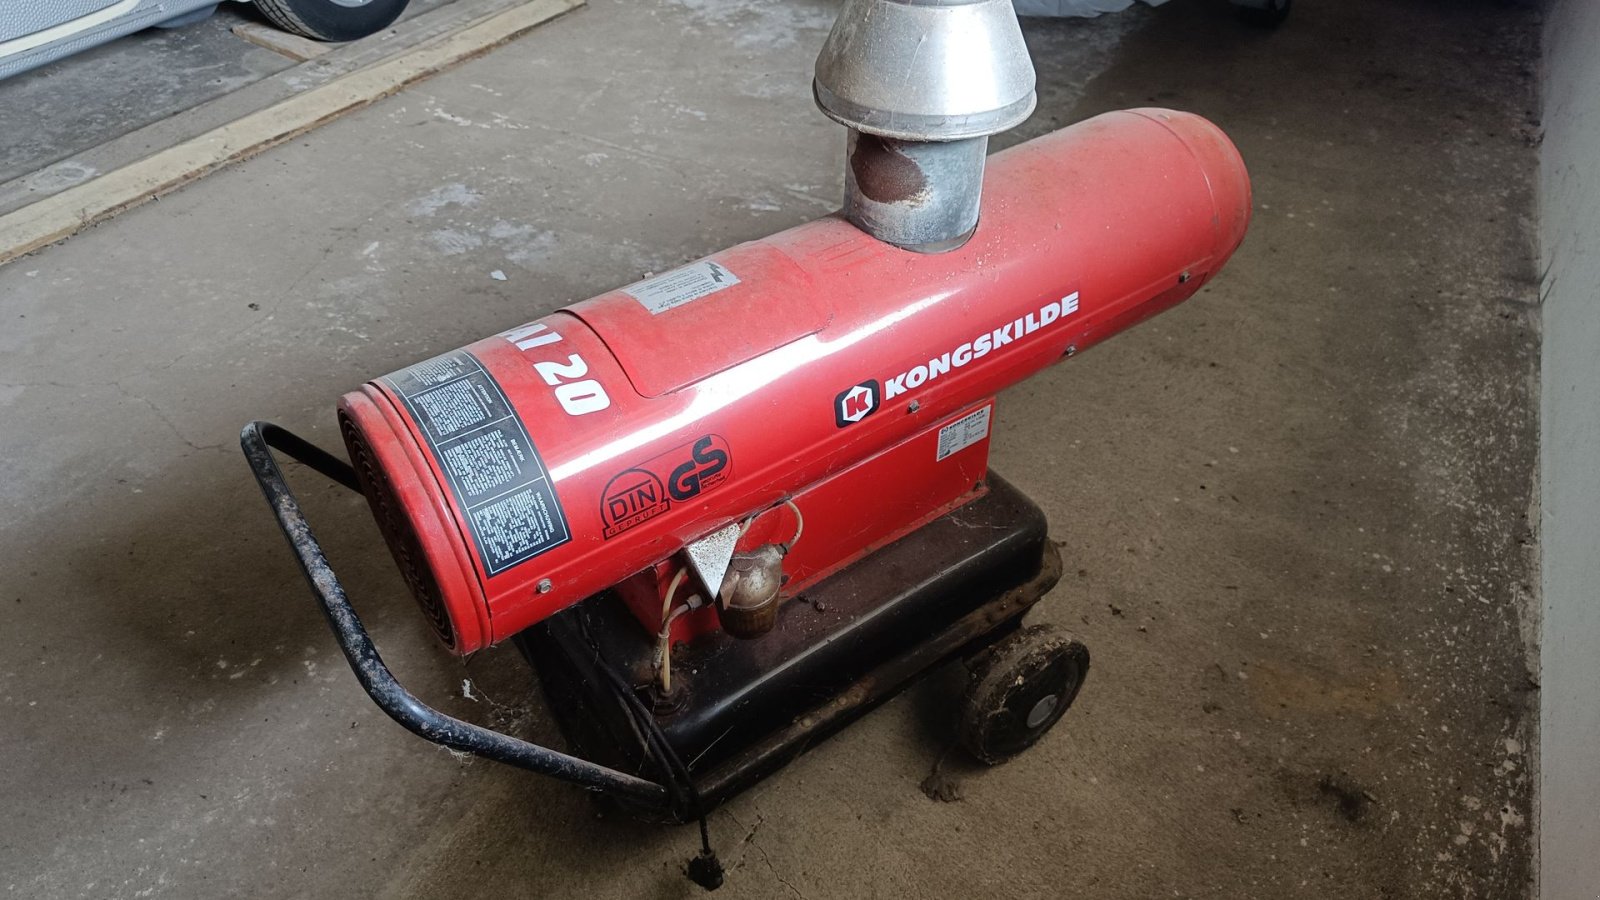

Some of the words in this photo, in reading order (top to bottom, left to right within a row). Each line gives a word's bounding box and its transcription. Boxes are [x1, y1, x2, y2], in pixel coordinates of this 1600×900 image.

[532, 353, 611, 417] 20
[845, 392, 869, 416] K
[885, 291, 1079, 400] KONGSKILDE
[668, 435, 728, 501] GS
[608, 483, 657, 522] DIN
